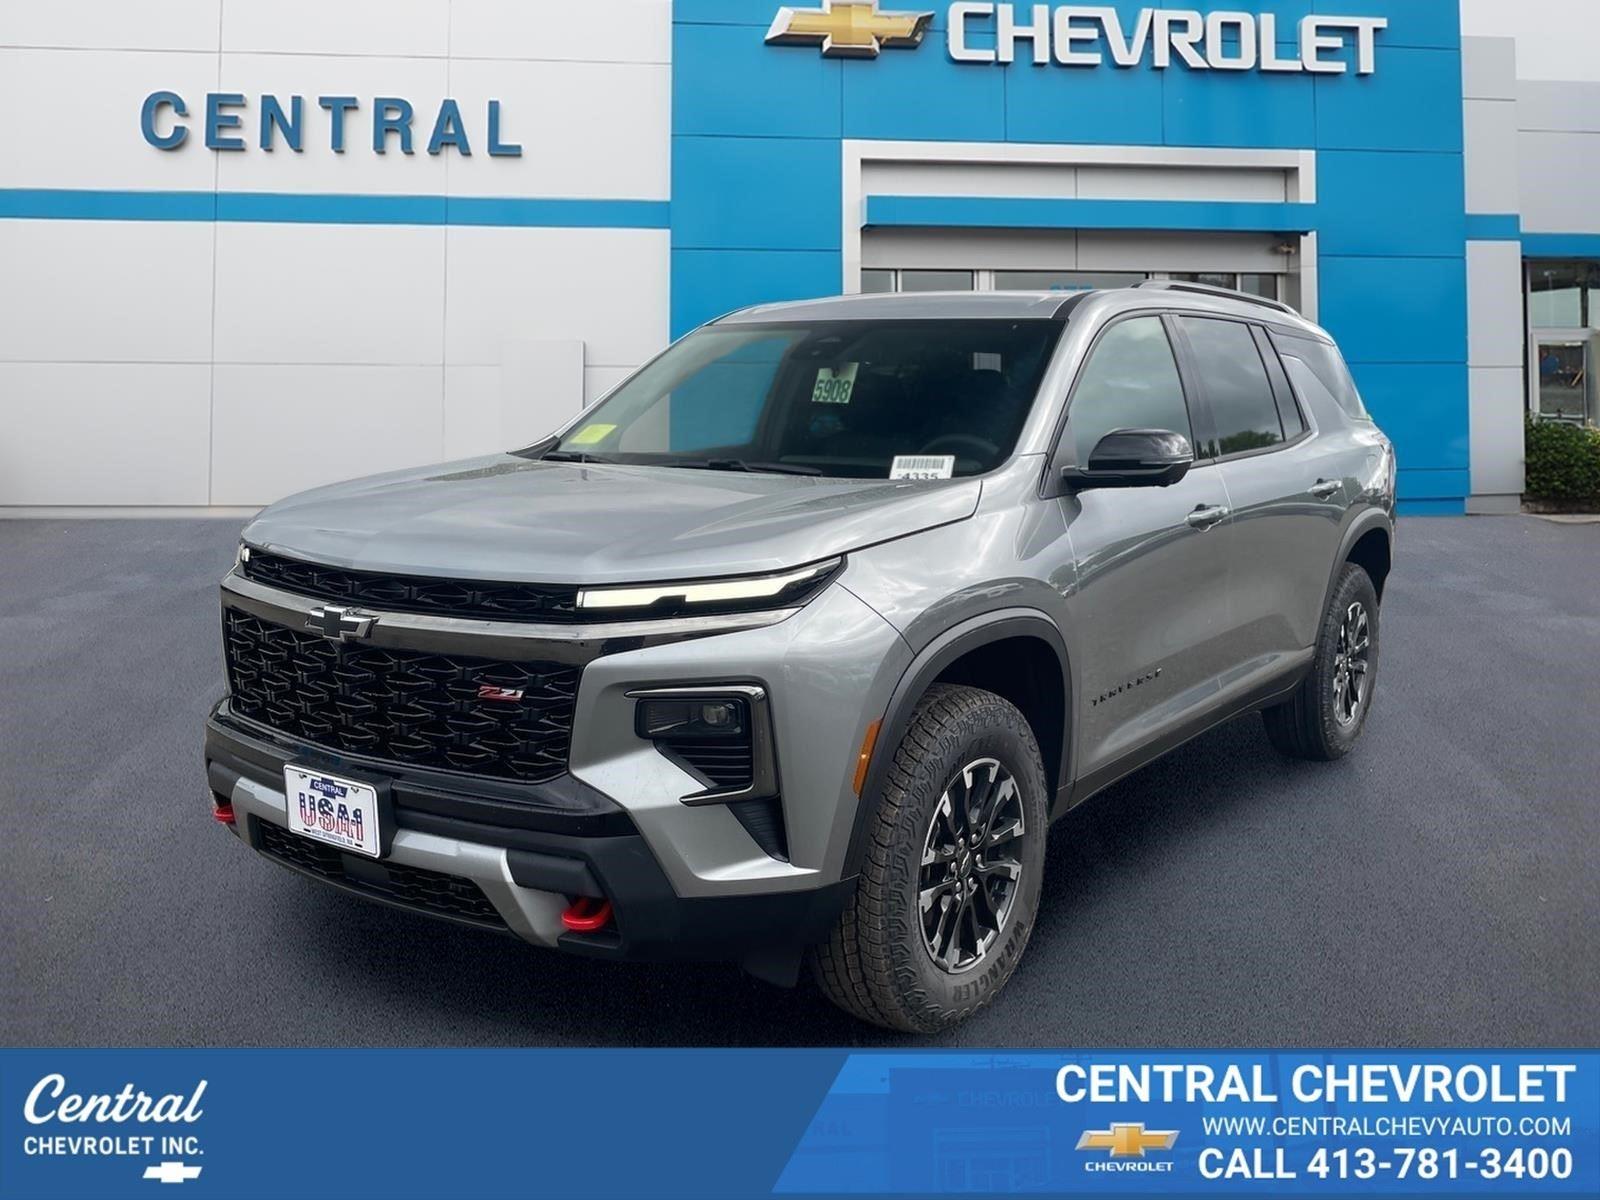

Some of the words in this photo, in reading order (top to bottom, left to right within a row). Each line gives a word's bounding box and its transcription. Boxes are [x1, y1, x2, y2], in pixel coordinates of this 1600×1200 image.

[946, 1, 1388, 76] CHEVROLET
[140, 90, 523, 157] CENTRAL
[814, 379, 851, 403] 5908
[313, 780, 345, 797] CENTRAL
[952, 919, 1025, 1001] WRANGLER
